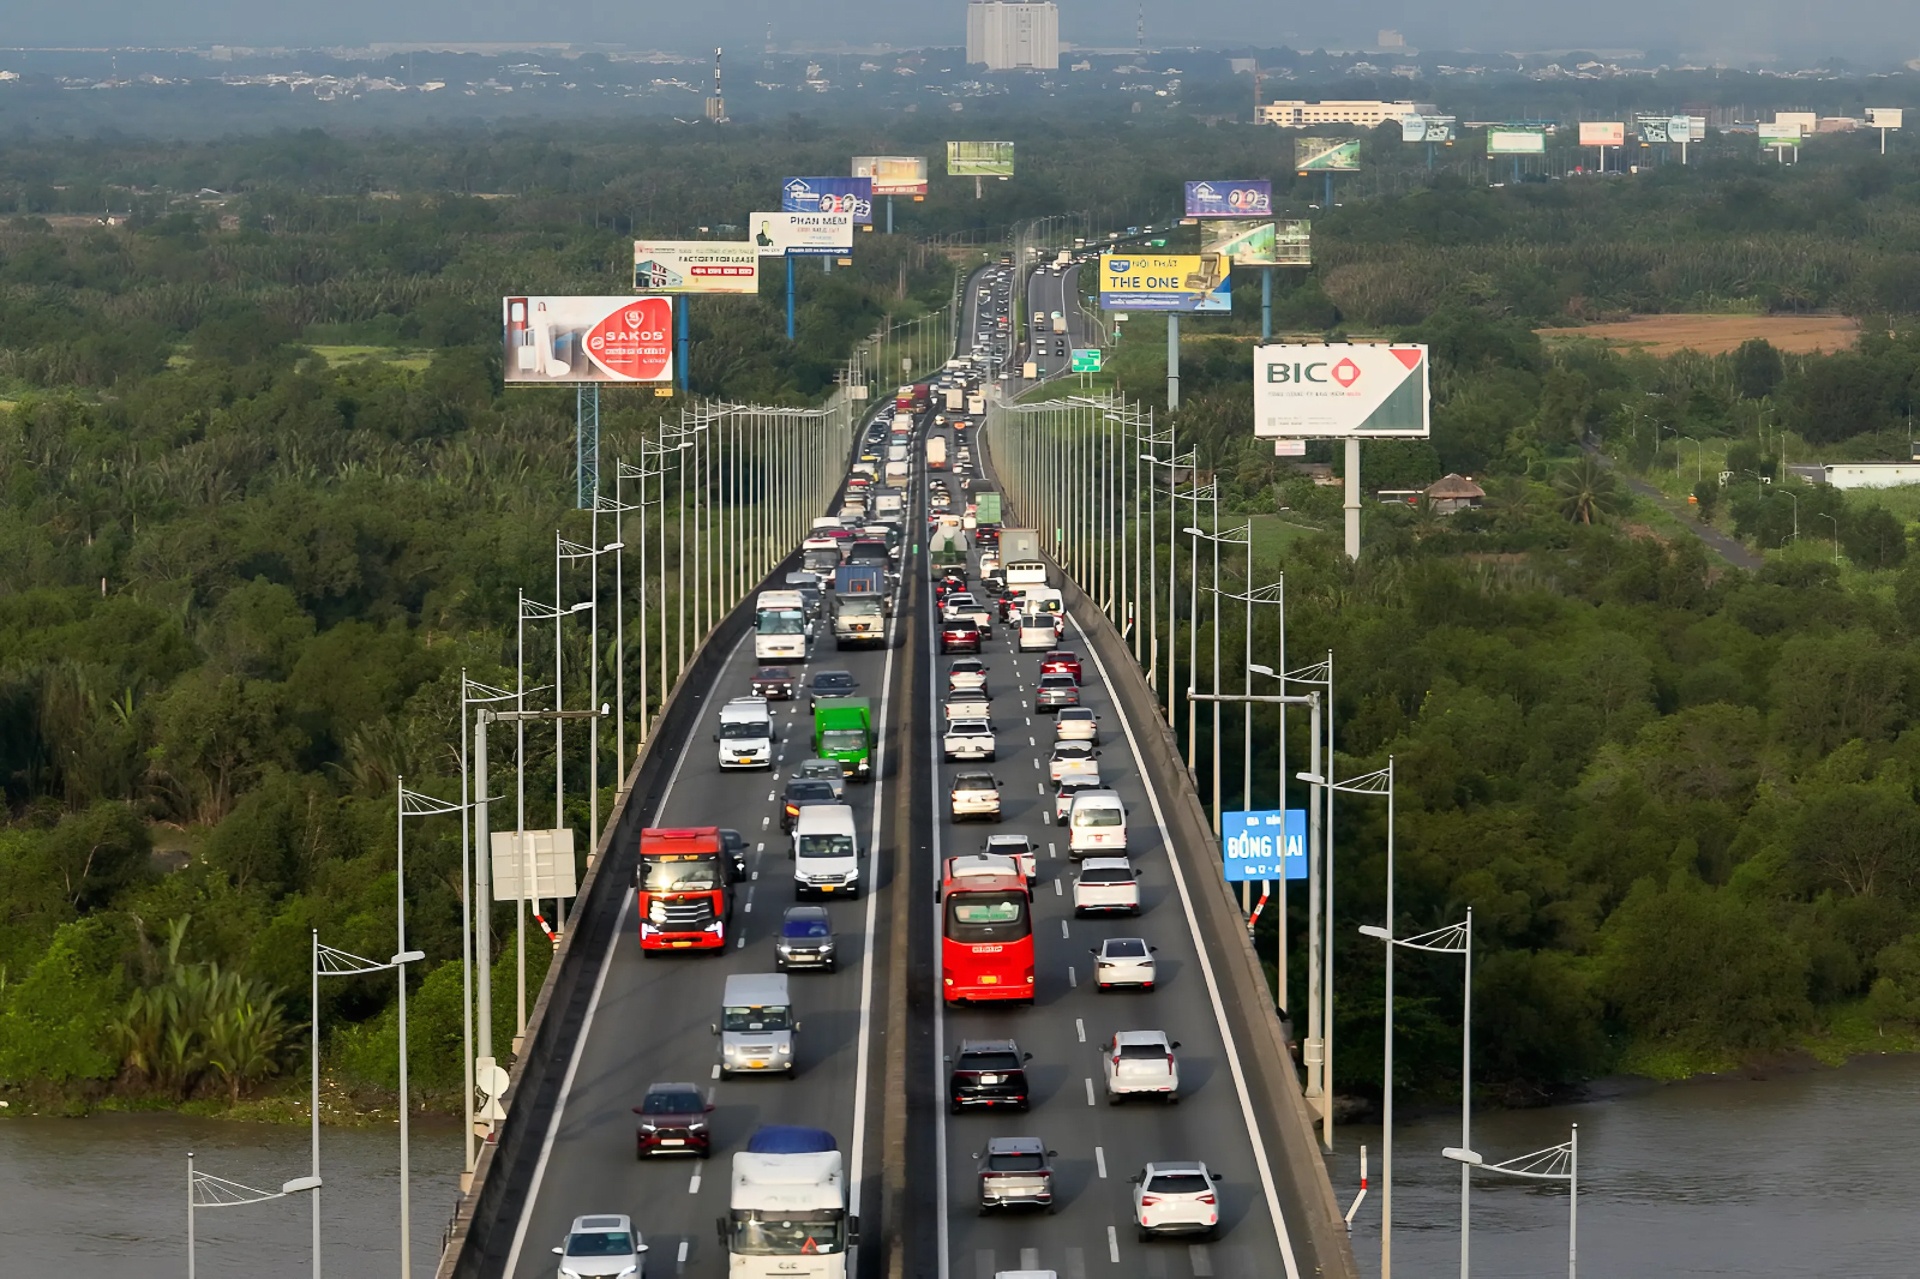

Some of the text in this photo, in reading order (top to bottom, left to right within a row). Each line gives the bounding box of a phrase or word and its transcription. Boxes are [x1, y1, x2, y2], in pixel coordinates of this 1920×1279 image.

[1110, 276, 1179, 288] THE ONE
[1267, 363, 1327, 383] BIC
